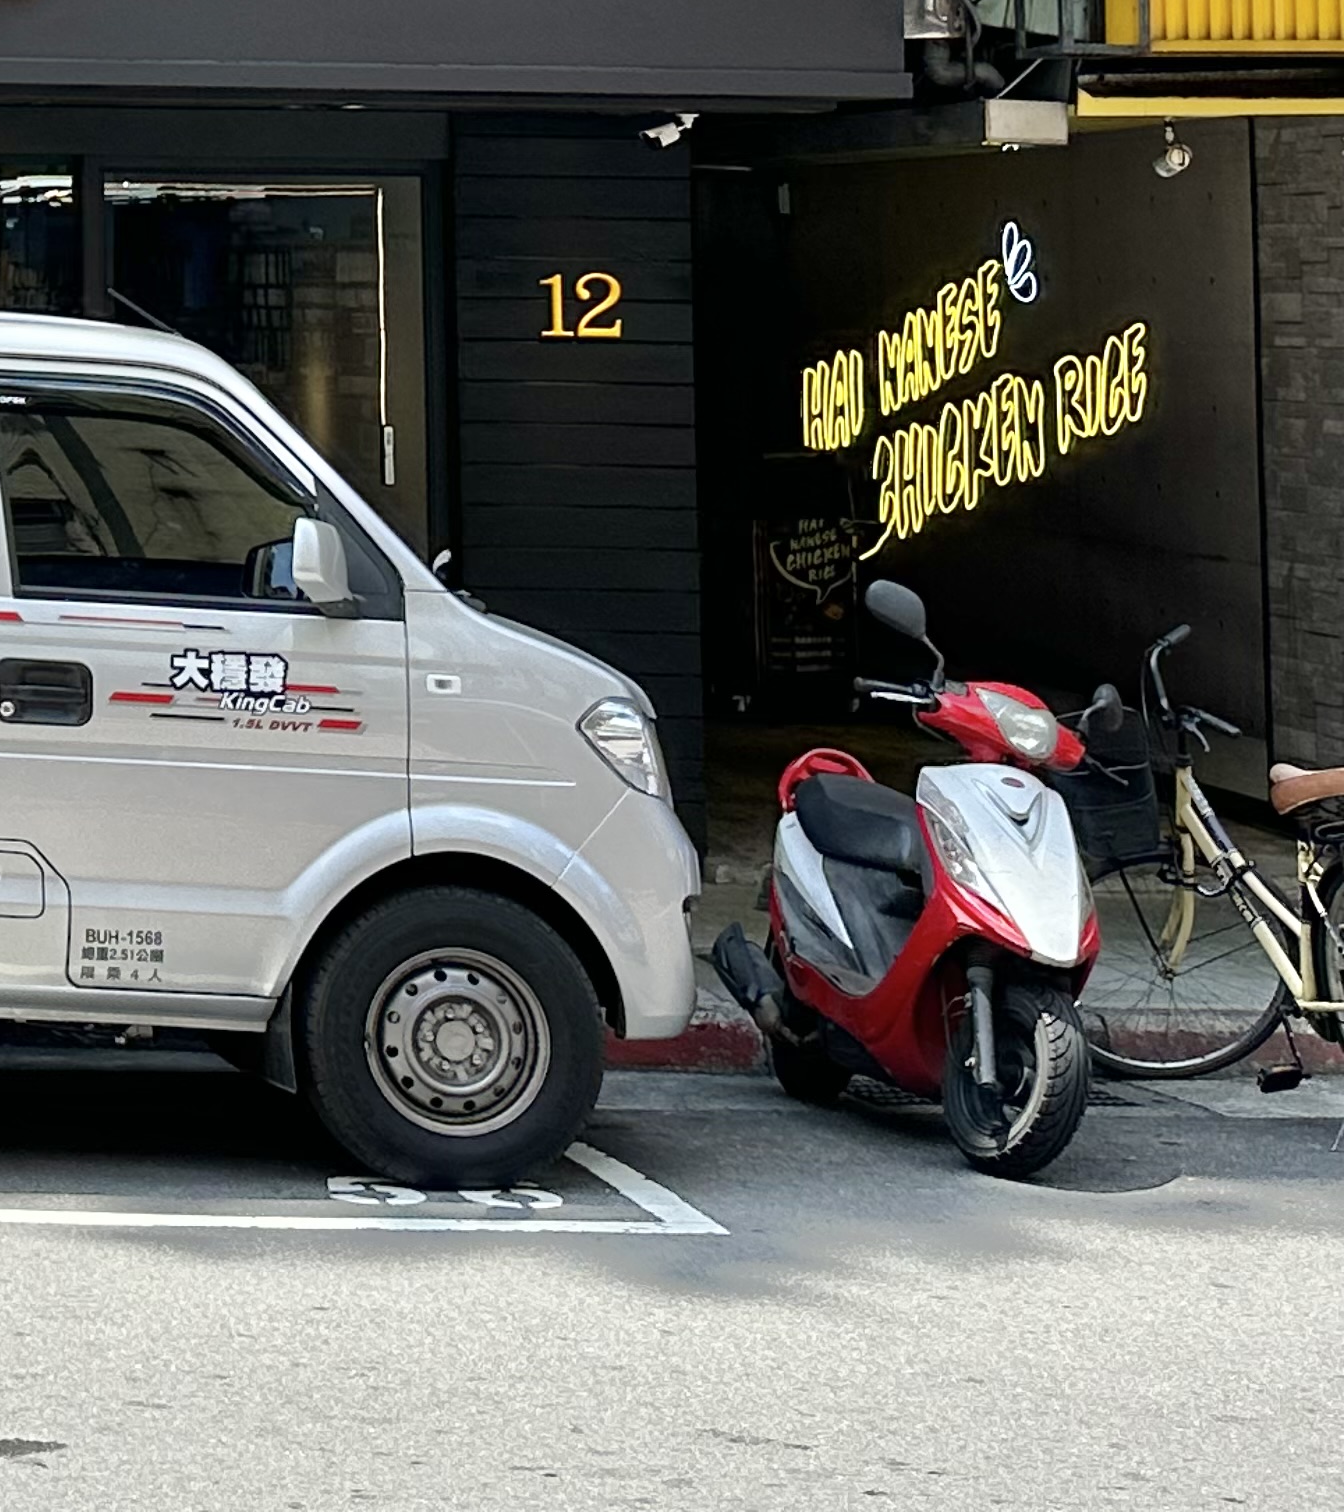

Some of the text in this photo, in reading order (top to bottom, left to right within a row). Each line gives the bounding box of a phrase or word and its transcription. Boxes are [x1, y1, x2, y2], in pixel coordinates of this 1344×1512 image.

[538, 271, 623, 338] 12
[802, 349, 864, 451] HAI
[870, 321, 1148, 540] CHICKEN RICE
[786, 543, 851, 572] CHICKEN
[218, 691, 312, 716] KingCab
[232, 717, 313, 733] 1.5L DVVT
[85, 928, 163, 946] BUH-1568
